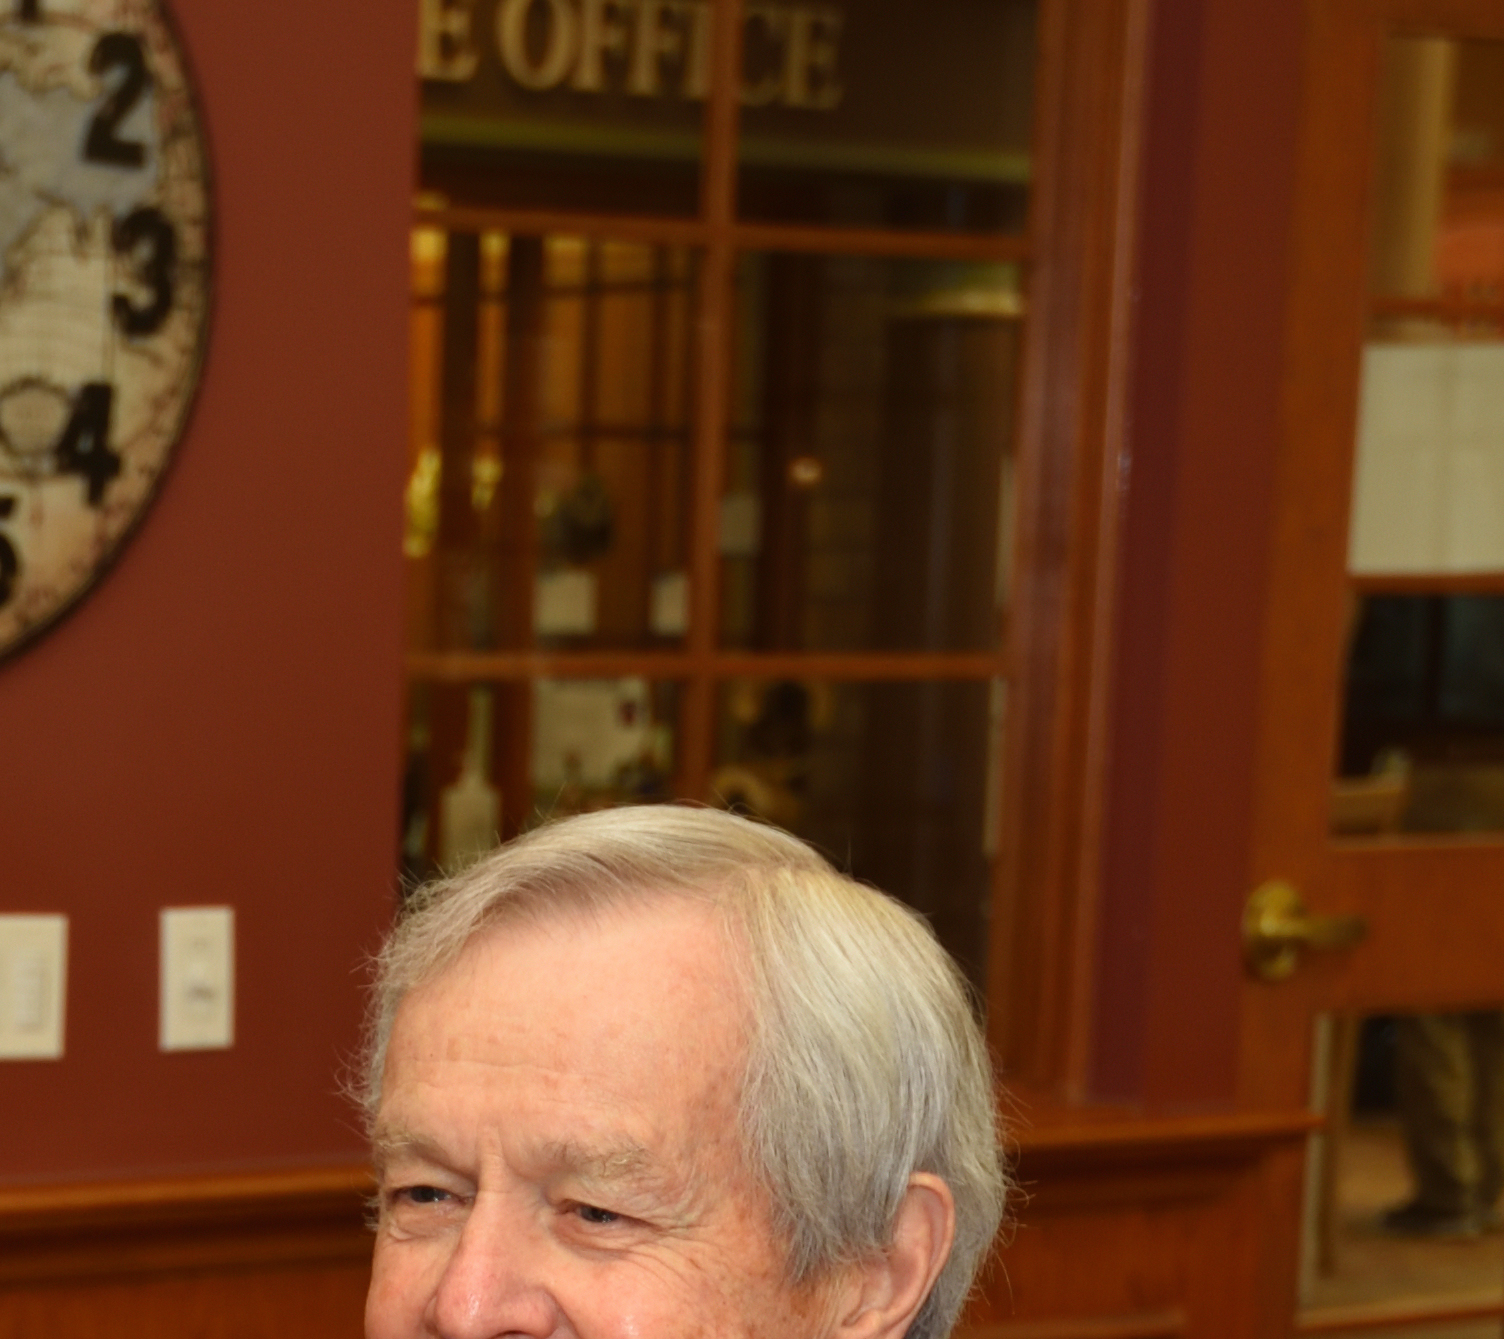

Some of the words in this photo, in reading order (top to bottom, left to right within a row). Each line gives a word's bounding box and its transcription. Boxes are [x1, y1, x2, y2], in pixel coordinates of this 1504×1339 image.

[82, 31, 150, 167] 2
[494, 0, 844, 110] OFFICE
[113, 206, 177, 338] 3
[54, 381, 123, 506] 4
